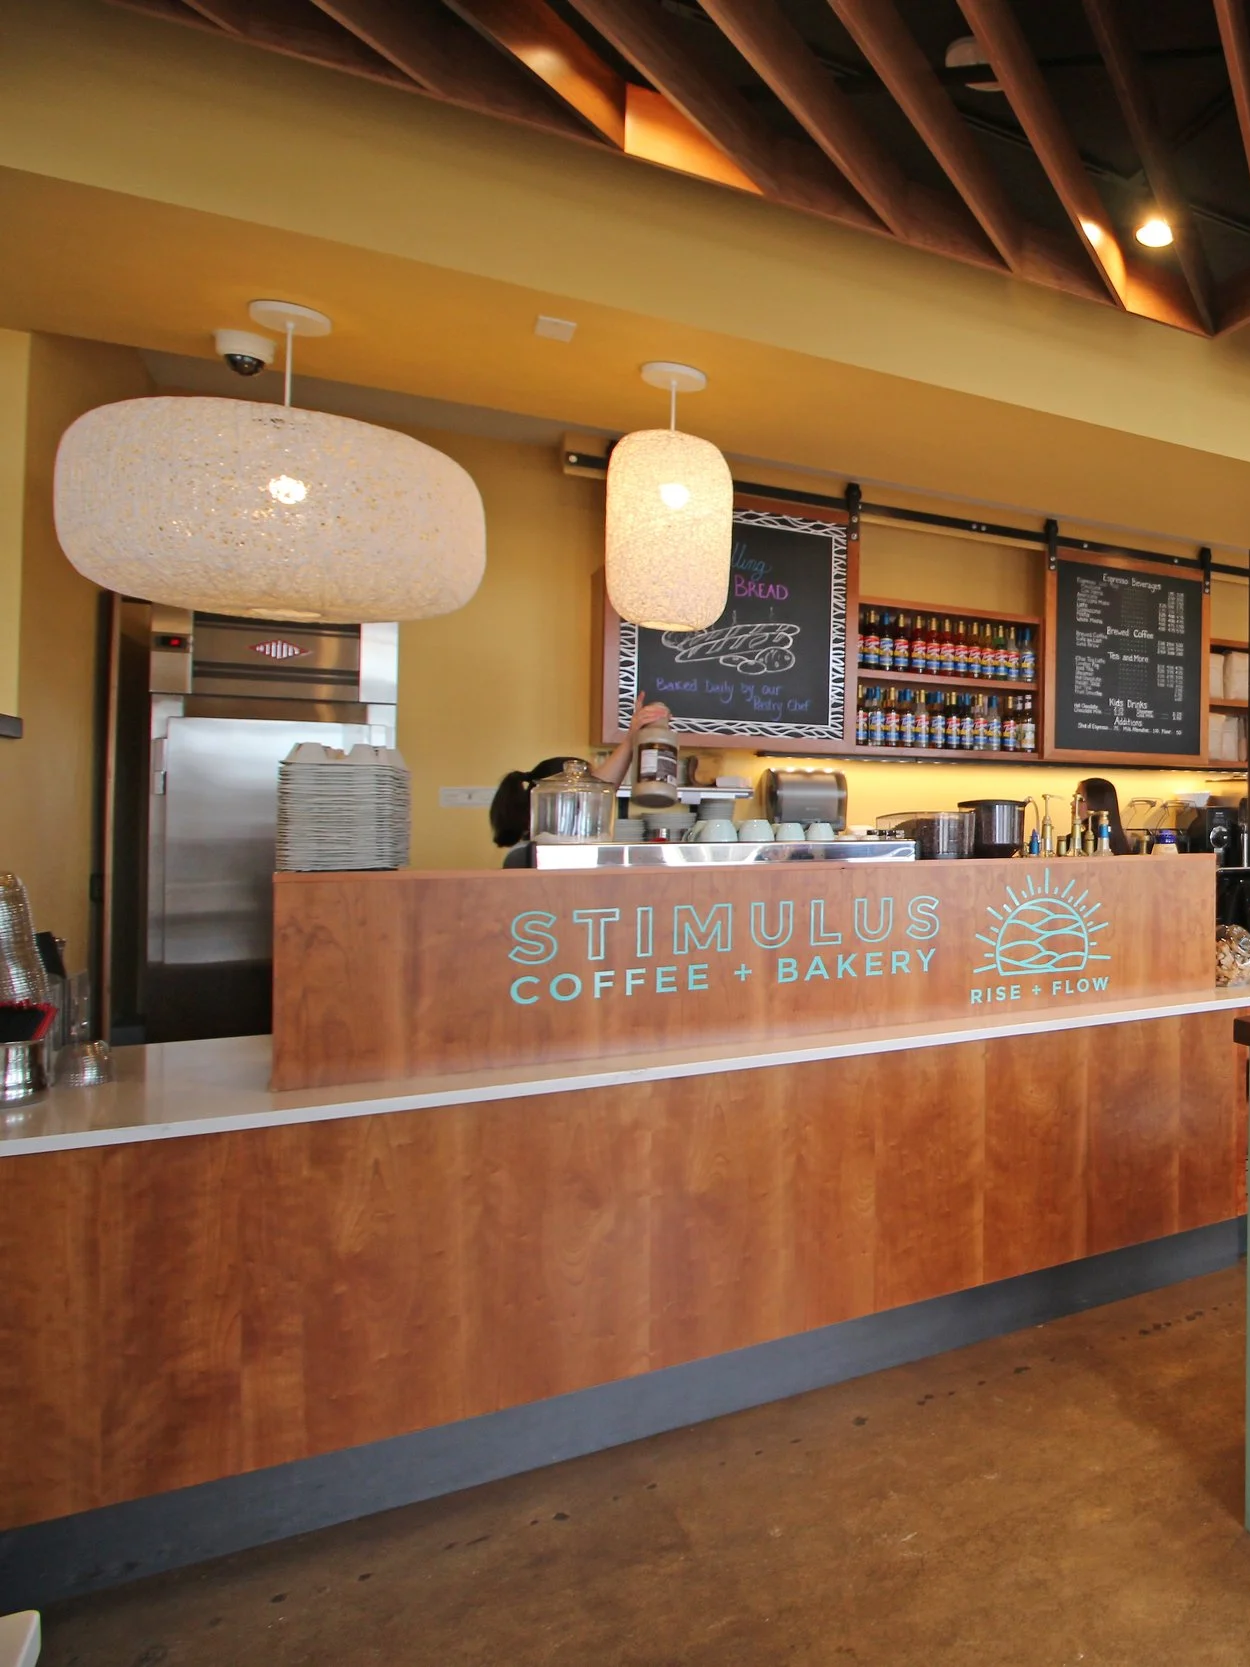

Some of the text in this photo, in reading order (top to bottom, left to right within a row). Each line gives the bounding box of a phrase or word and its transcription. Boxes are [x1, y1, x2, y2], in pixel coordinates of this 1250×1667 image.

[734, 574, 789, 600] BREAD
[1102, 573, 1129, 587] Espresso
[1131, 577, 1161, 593] Beverages
[1106, 626, 1154, 640] Brewed Coffee
[1107, 652, 1120, 660] Tea
[1133, 655, 1149, 663] More
[656, 678, 782, 704] Baked Daily by our
[753, 697, 811, 721] Pastry Chef
[1109, 698, 1148, 710] Kids Drinks
[1113, 716, 1143, 727] Additions
[508, 895, 941, 965] STIMULUS
[509, 948, 937, 1005] COFFEE + BAKERY
[970, 976, 1109, 1005] RISE + FLOW
